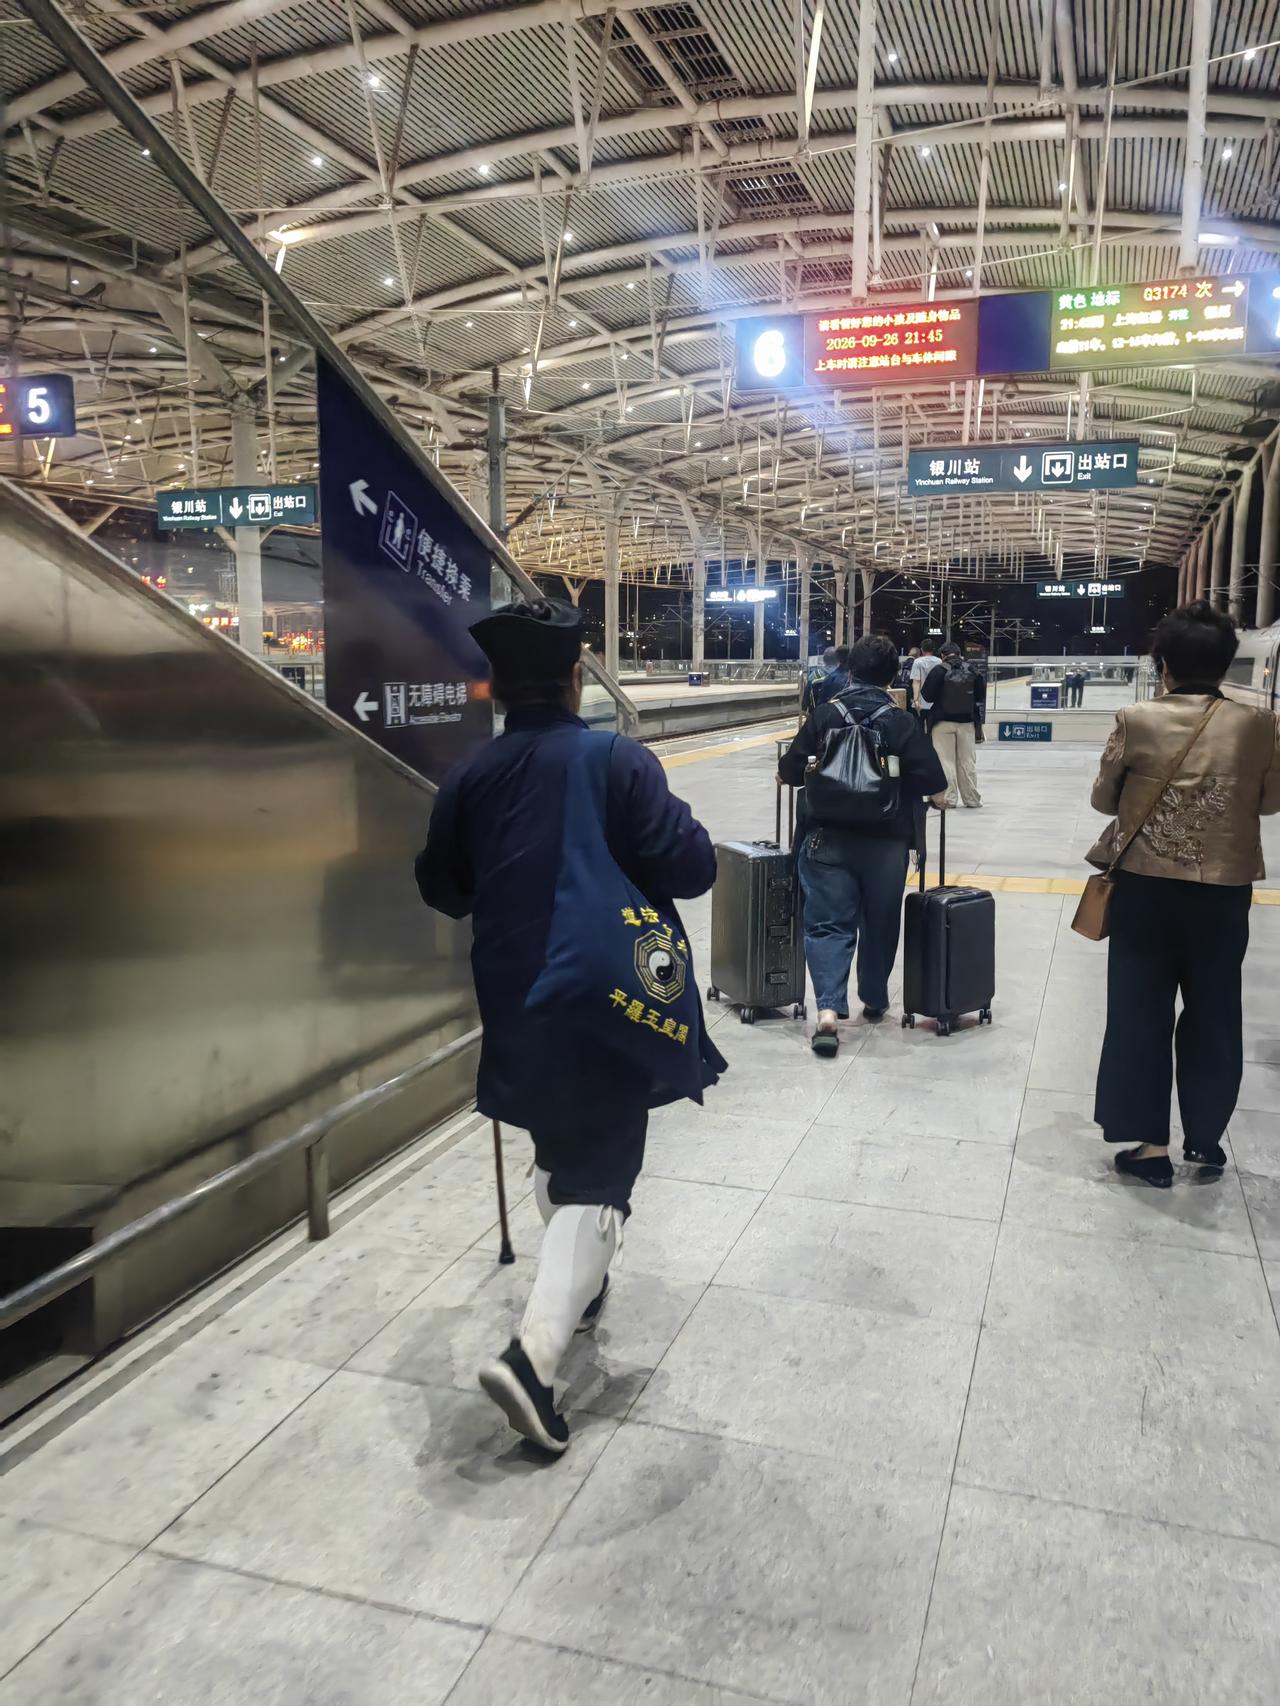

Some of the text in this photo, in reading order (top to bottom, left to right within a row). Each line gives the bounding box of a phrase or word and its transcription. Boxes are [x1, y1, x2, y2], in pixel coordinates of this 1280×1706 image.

[1058, 281, 1213, 311] 黄色 地标 G3174 次
[825, 329, 943, 351] 2026-09-26 21:45
[753, 329, 787, 378] 6
[28, 386, 50, 424] 5
[929, 458, 981, 477] 银川站
[1077, 452, 1128, 471] 出站口
[915, 475, 994, 487] Yinchuan Railway Station
[1077, 472, 1092, 480] Exit
[170, 499, 207, 515] 银川站
[272, 495, 306, 510] 出站口
[408, 682, 467, 707] 无障碍电梯
